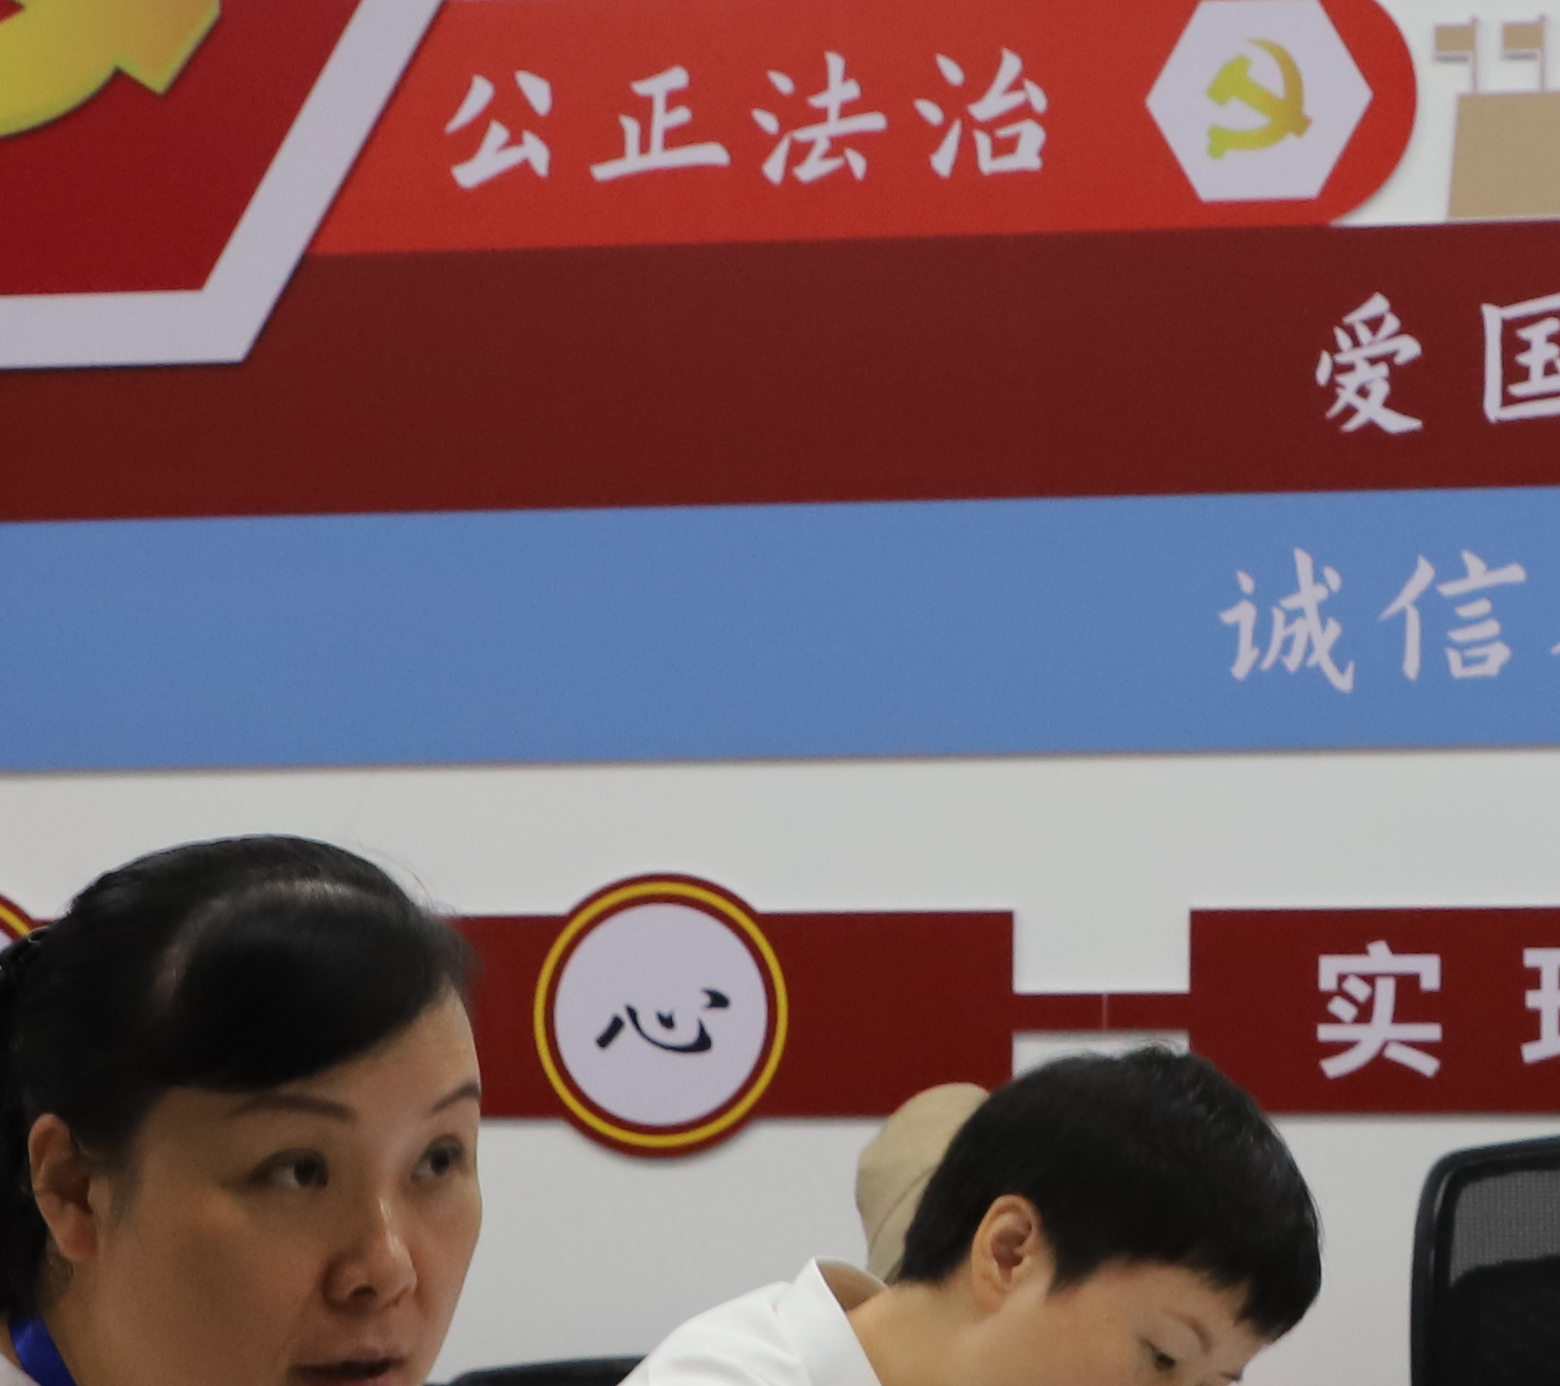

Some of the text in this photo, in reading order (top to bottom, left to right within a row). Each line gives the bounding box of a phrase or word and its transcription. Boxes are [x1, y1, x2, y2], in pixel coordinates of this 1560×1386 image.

[443, 46, 1051, 191] 公正法治
[593, 983, 731, 1056] 心
